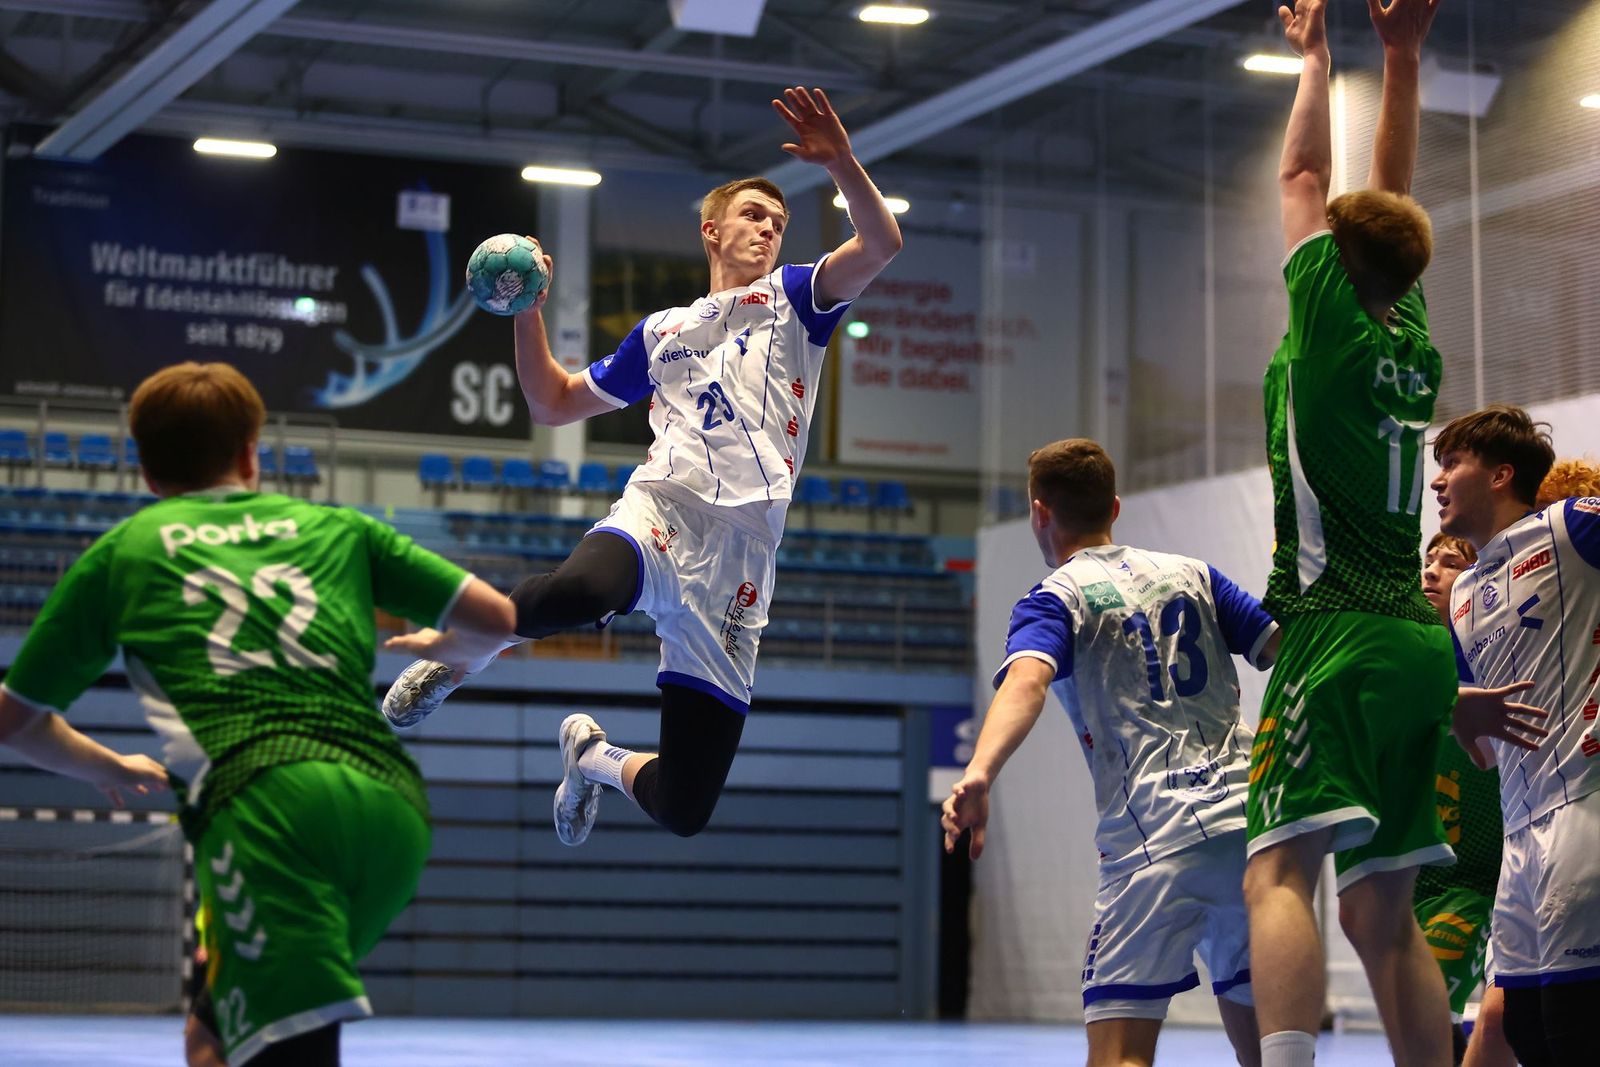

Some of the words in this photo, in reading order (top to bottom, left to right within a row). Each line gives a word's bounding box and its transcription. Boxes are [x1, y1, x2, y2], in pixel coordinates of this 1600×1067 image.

[91, 242, 338, 290] Weltmarktführer
[104, 280, 140, 307] für
[186, 320, 228, 346] seit
[233, 322, 284, 354] 1879
[697, 381, 736, 430] 23
[1377, 415, 1432, 516] 17
[159, 513, 298, 559] porta
[1512, 549, 1552, 581] SABO
[182, 562, 338, 676] 22
[1094, 593, 1120, 609] AOK
[1122, 596, 1208, 700] 13
[217, 987, 253, 1047] 22
